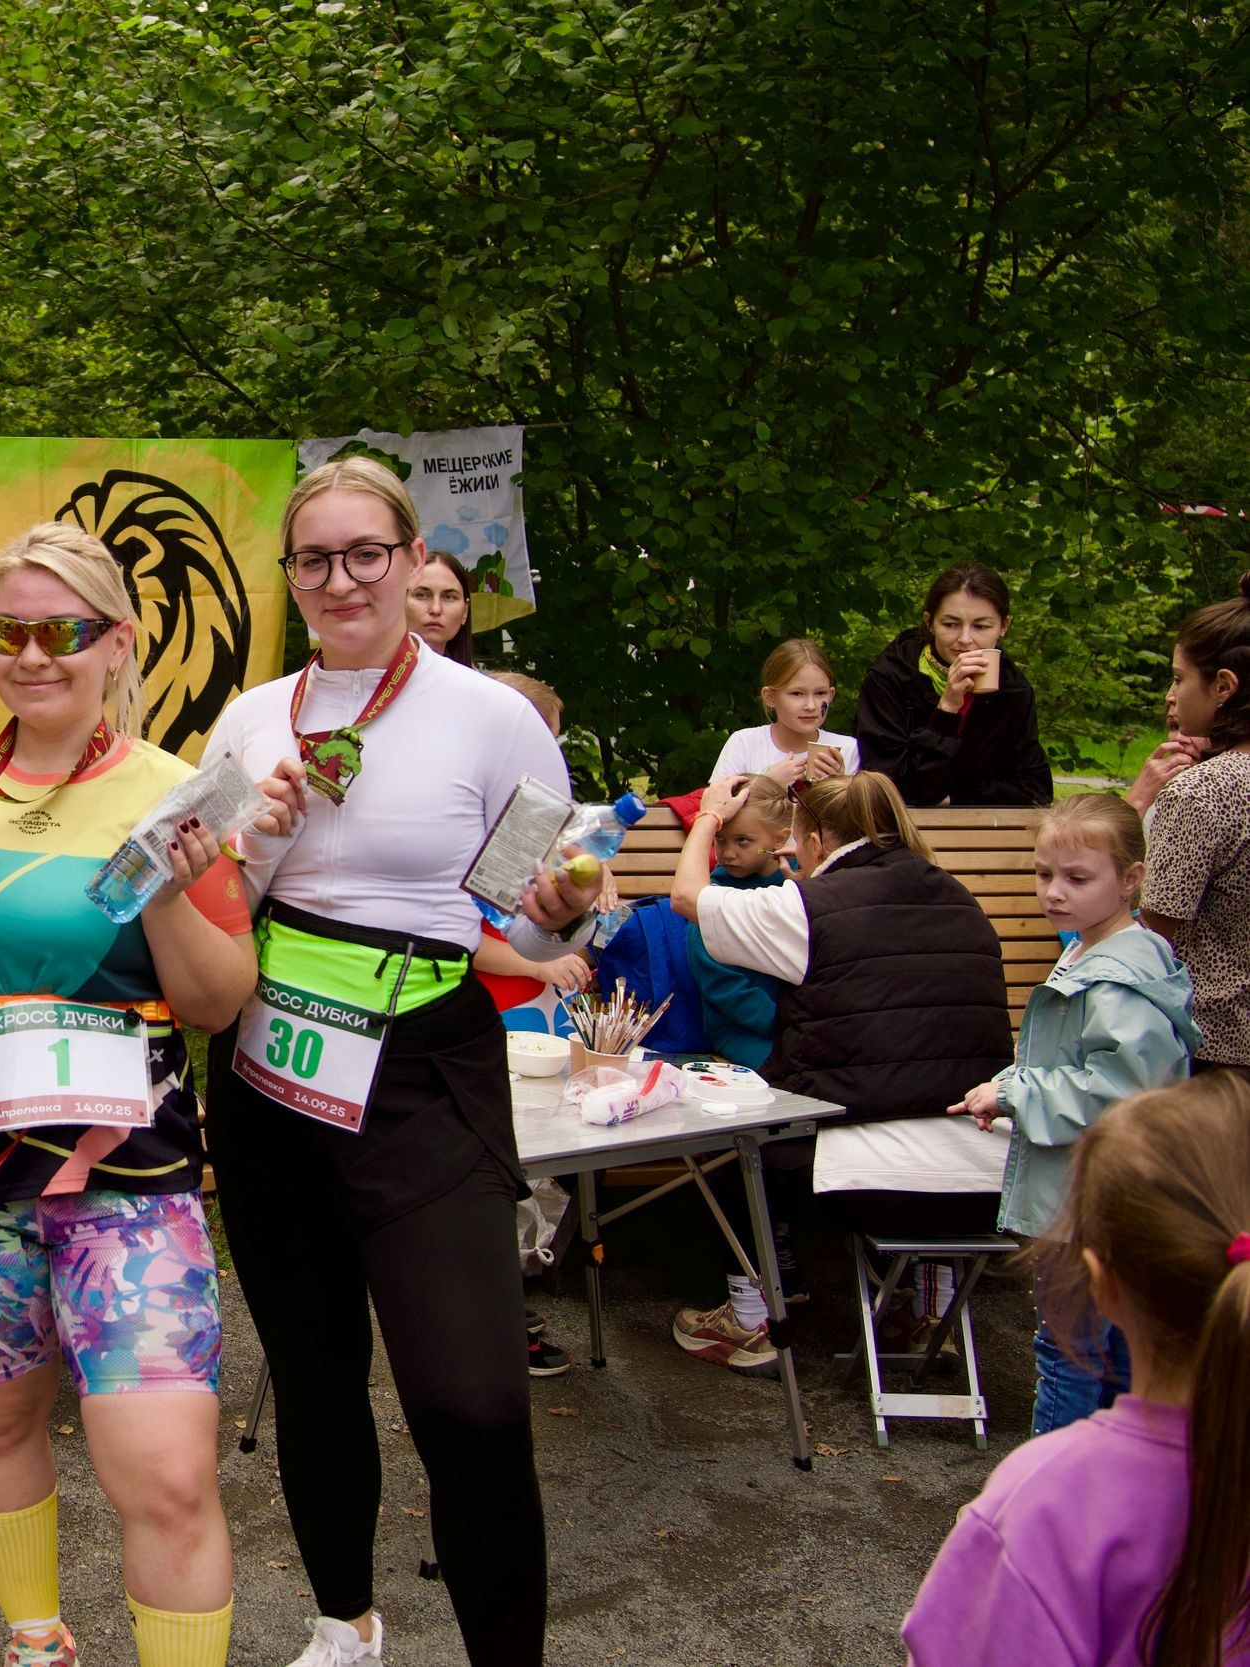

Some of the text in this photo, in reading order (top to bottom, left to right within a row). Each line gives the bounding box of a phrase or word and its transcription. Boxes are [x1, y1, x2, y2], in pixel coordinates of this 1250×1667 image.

[423, 449, 512, 474] МЕЩЕРСКИЕ
[62, 1010, 125, 1031] ДУБКИ
[257, 980, 369, 1030] РОСС ДУБКИ
[47, 1038, 71, 1086] 1
[265, 1018, 324, 1080] 30
[74, 1102, 132, 1117] 14.09.25
[242, 1061, 346, 1118] Апрелевка 14.09.25
